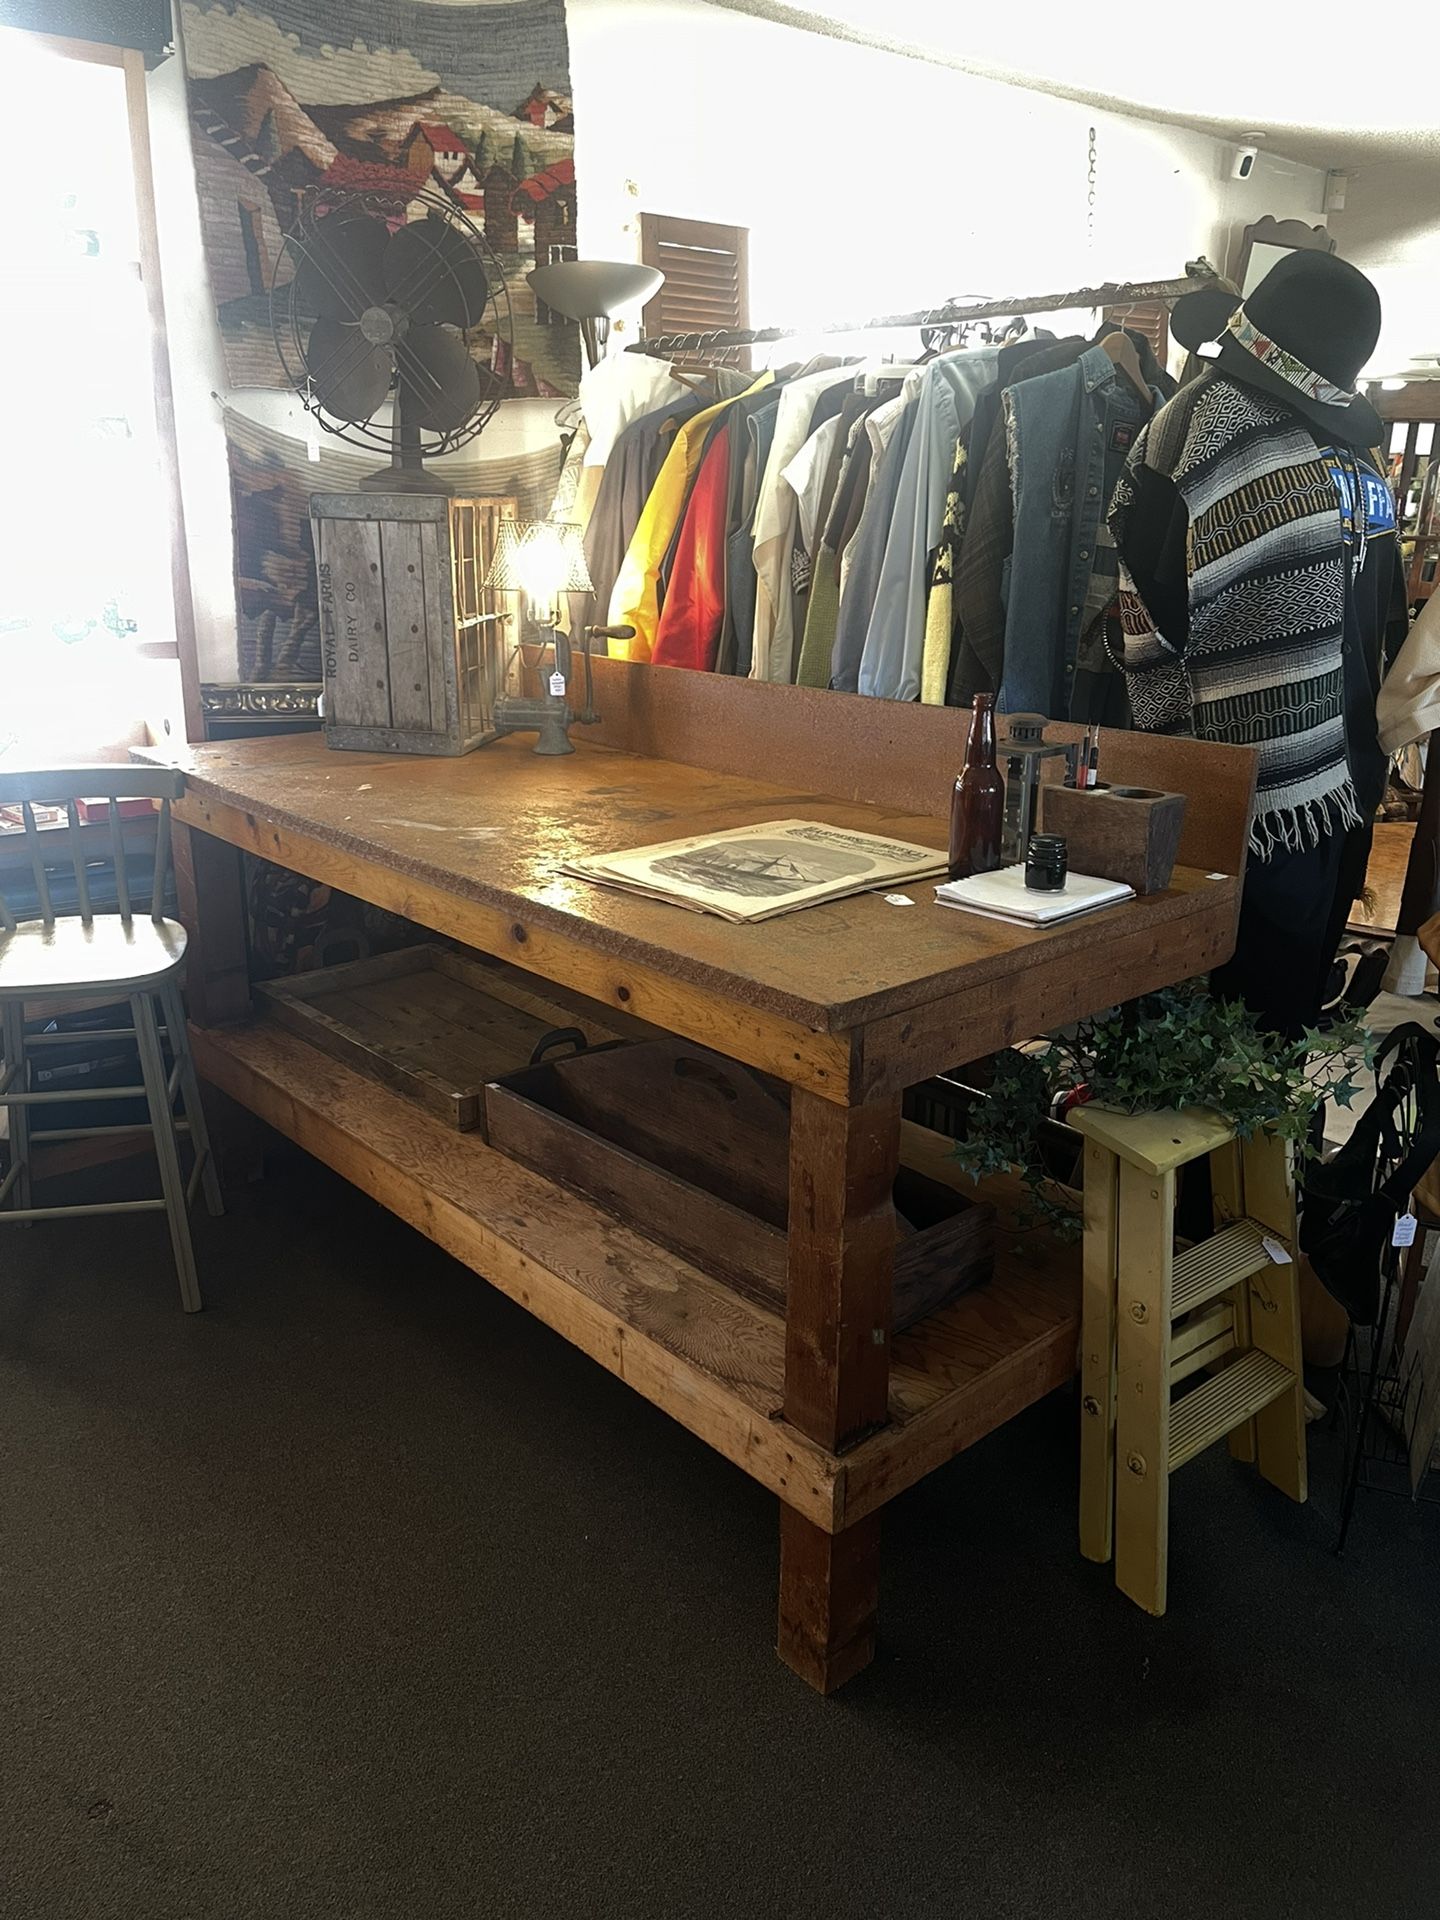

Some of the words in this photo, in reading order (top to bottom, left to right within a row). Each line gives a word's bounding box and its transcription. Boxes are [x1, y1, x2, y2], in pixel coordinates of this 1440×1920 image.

[1367, 480, 1394, 521] FFA
[319, 563, 333, 614] FARMS
[346, 582, 356, 602] CO
[325, 629, 337, 679] ROYAL
[347, 615, 359, 661] DAIRY
